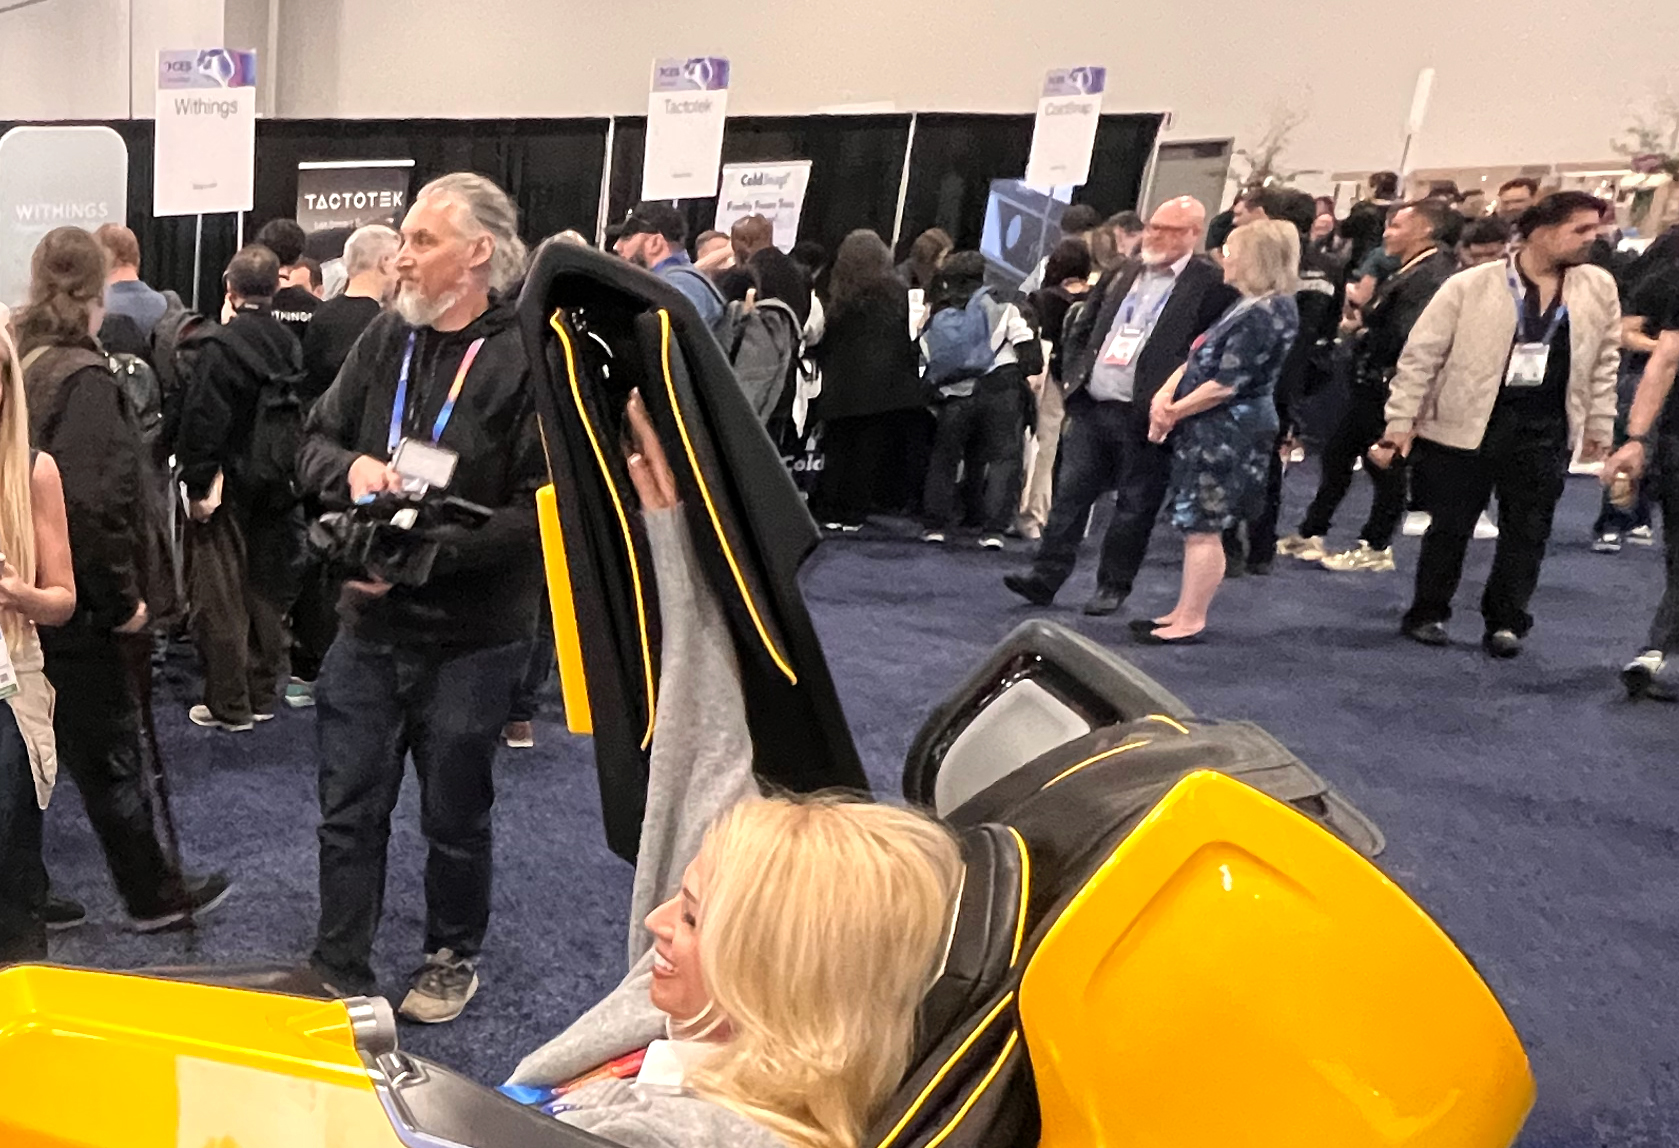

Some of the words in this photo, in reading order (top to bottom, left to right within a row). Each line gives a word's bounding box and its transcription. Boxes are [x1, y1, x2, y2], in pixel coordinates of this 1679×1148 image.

[174, 97, 239, 119] Withings
[664, 98, 713, 115] Tactotek
[14, 201, 109, 220] WITHINGS
[303, 191, 404, 211] TACTOTEK
